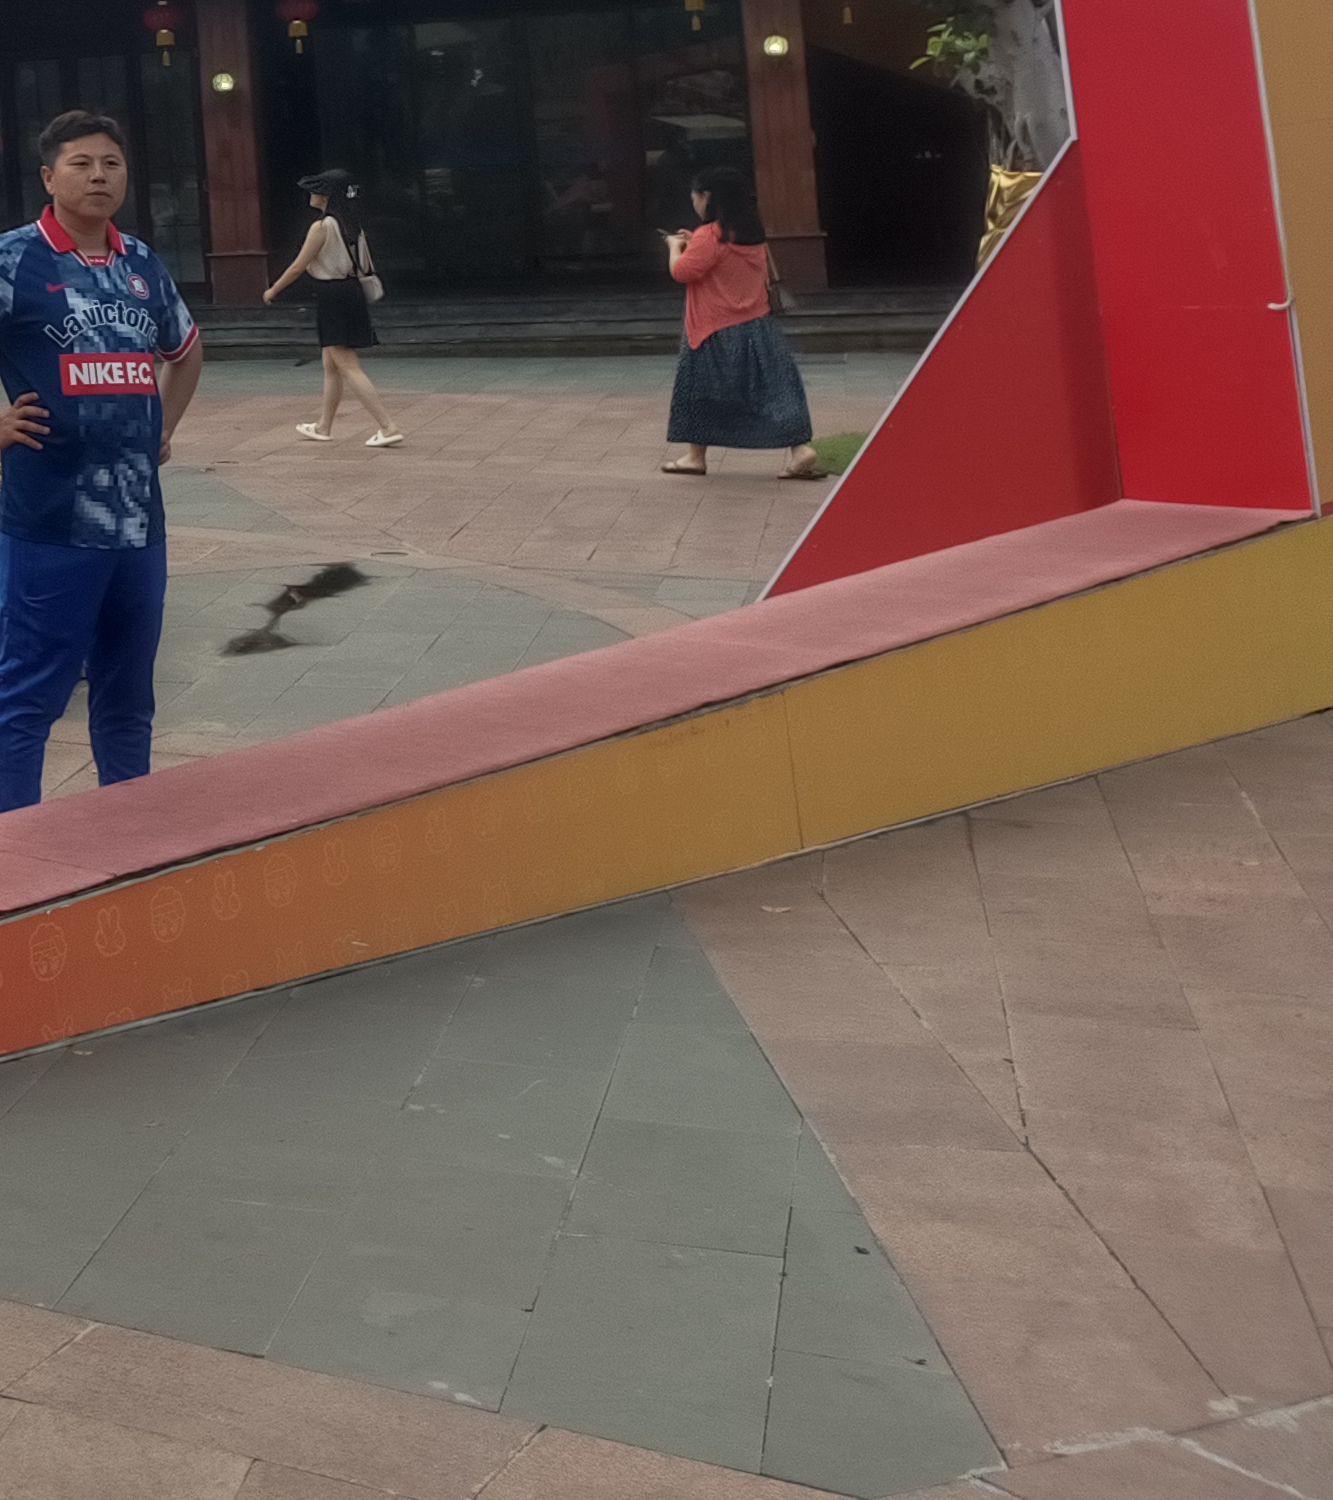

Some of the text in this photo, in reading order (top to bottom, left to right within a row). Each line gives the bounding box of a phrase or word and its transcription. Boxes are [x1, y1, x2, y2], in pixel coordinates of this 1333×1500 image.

[44, 312, 84, 348] La
[69, 361, 154, 386] NIKE F.C.
